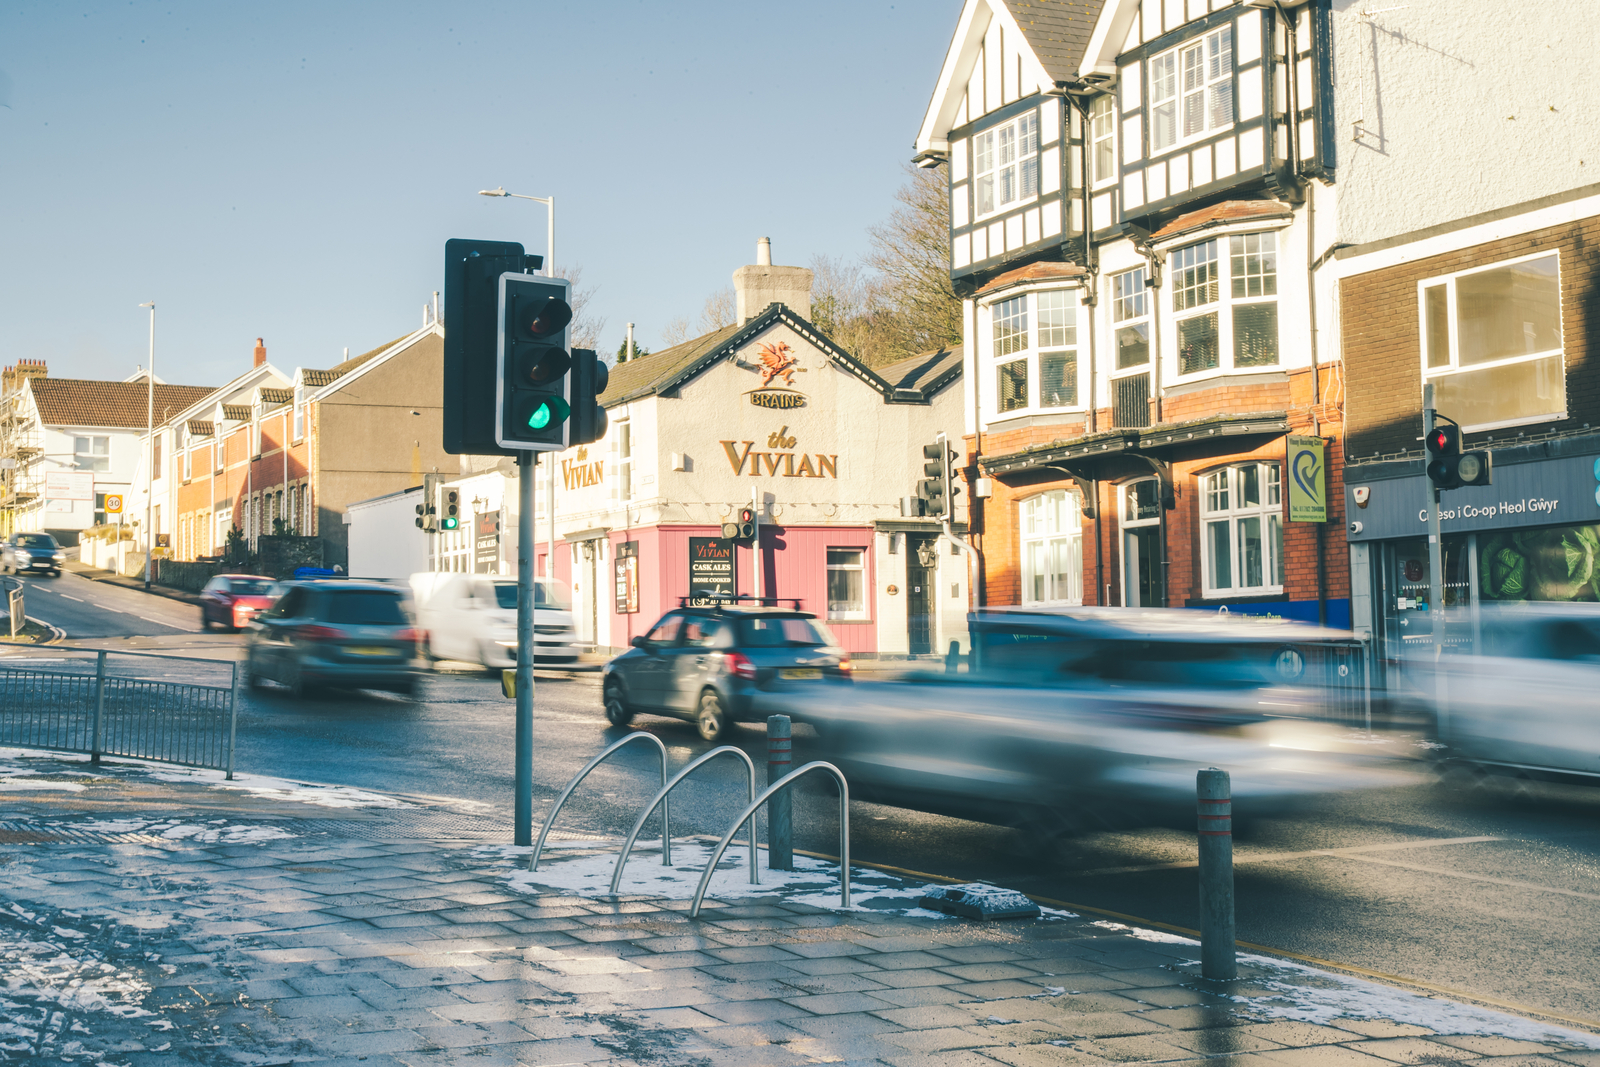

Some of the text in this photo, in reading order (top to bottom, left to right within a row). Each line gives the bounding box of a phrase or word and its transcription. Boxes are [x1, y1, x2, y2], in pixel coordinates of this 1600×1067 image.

[750, 393, 804, 409] BRAINS
[767, 425, 798, 449] the
[719, 440, 838, 479] VIVIAN
[561, 457, 604, 491] VIVIAN
[109, 499, 120, 507] 30
[1419, 497, 1559, 522] Ceso i Co-op Heol Gŵyr
[696, 545, 730, 558] VIVIAN
[692, 563, 731, 571] CASK ALES
